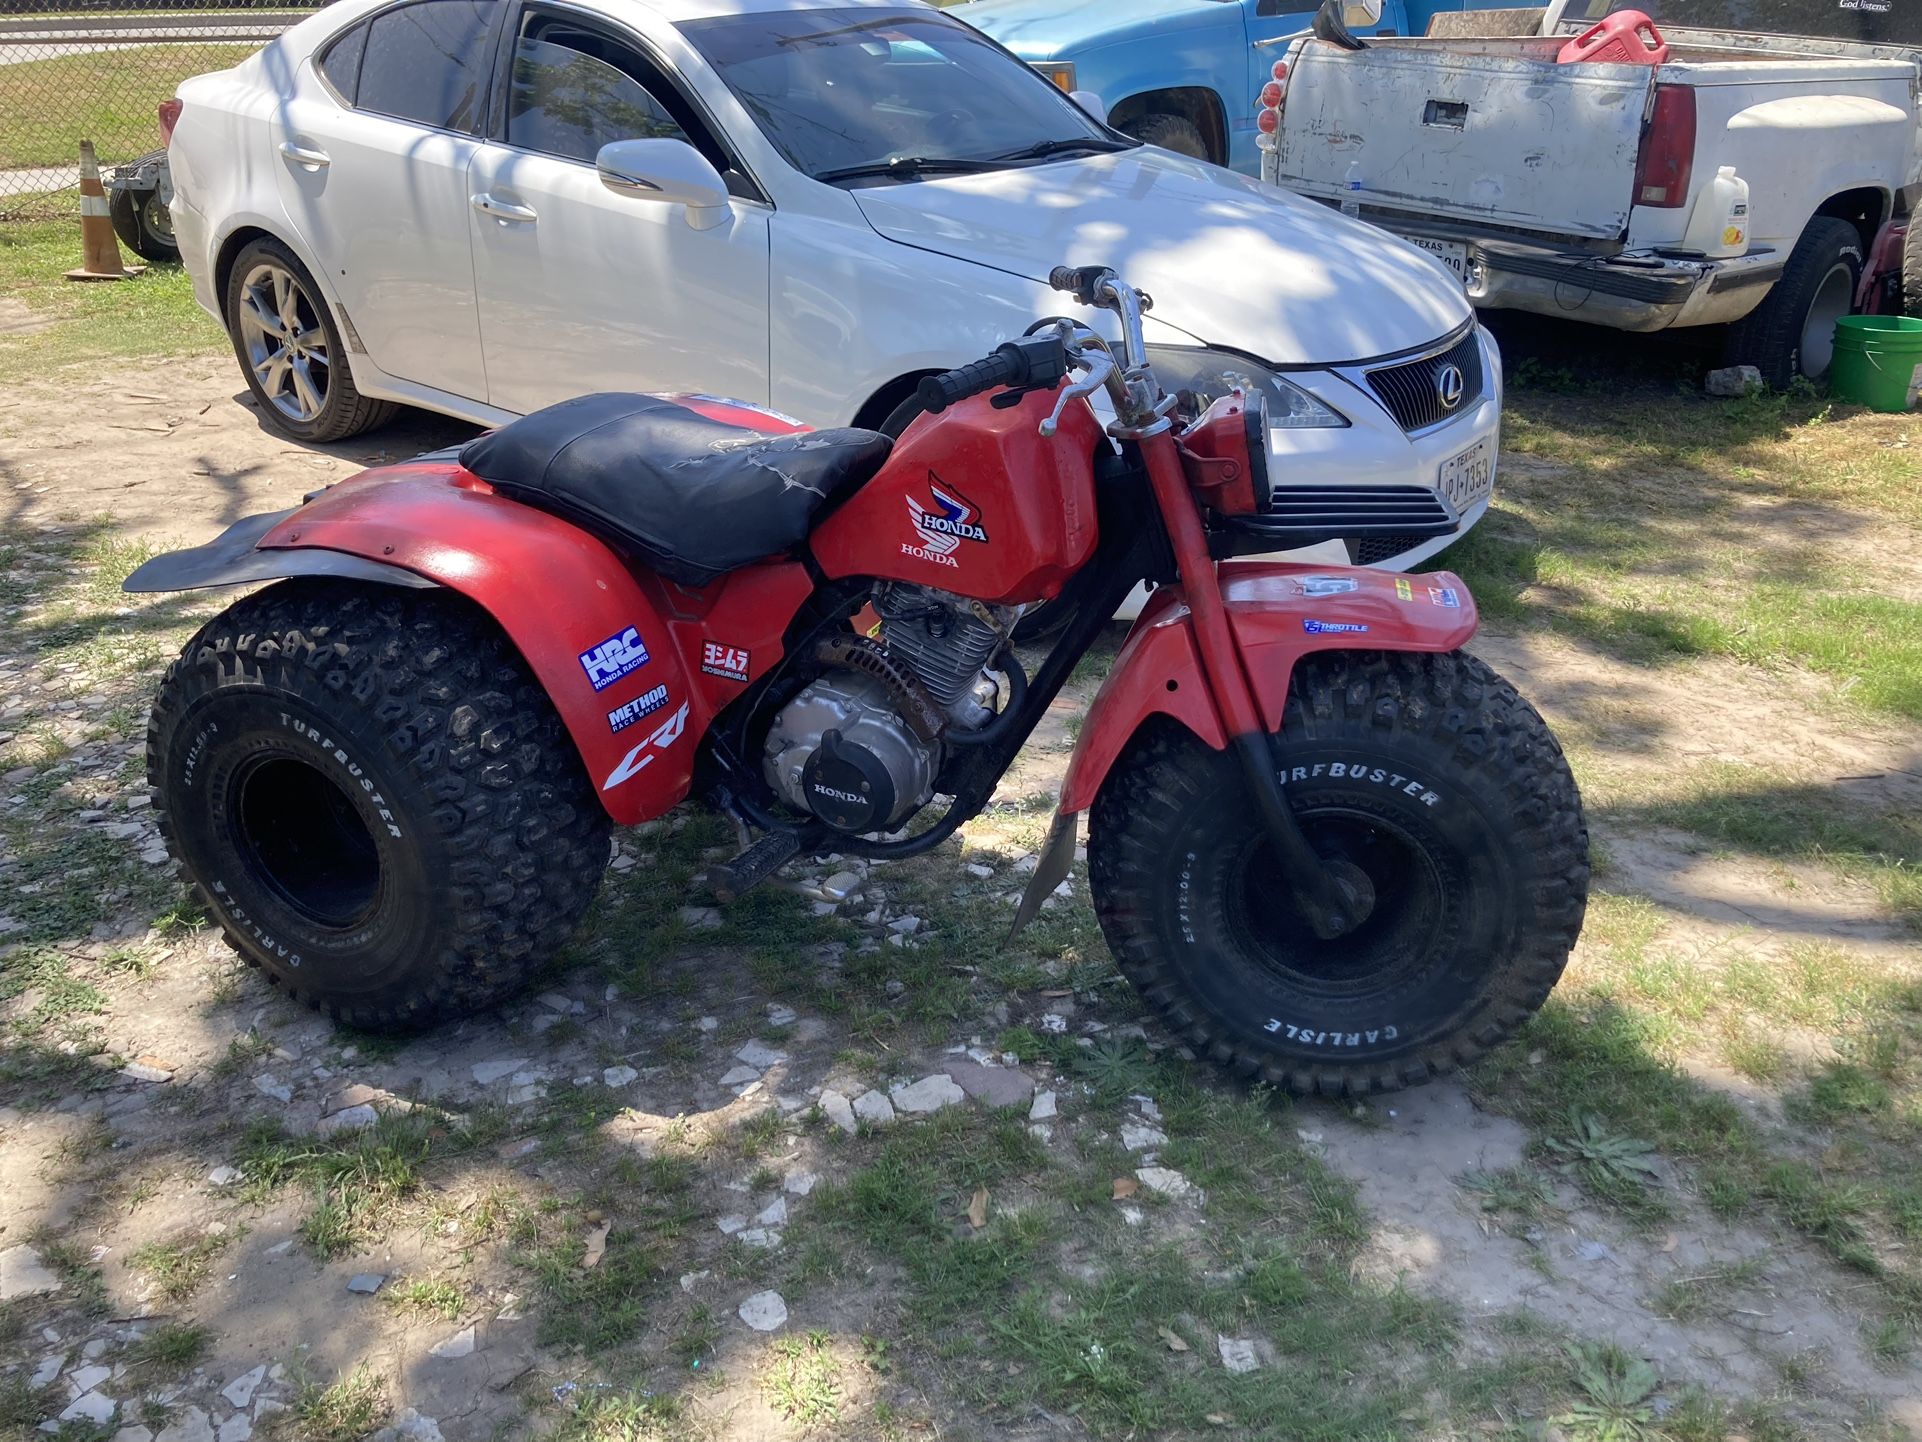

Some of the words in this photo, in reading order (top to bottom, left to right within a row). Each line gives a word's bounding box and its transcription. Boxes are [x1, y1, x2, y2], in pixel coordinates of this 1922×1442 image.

[1413, 239, 1443, 251] TEXAS
[1457, 447, 1477, 467] TEXAS
[923, 514, 987, 541] HONDA
[900, 543, 960, 568] HONDA
[1320, 622, 1369, 633] THROTTLE
[580, 627, 647, 683] HRC
[704, 643, 749, 672] ヨシムラ
[594, 670, 623, 690] HONDA
[622, 653, 649, 673] RACING
[702, 664, 748, 682] YOSHIMURA
[607, 684, 668, 726] METHOD
[612, 715, 635, 733] RACE
[638, 695, 669, 719] WHEELS
[603, 697, 690, 791] CRF
[281, 712, 402, 838] TURFBUSTER
[814, 783, 869, 805] HONDA
[211, 880, 301, 968] CARLISLE
[1263, 1017, 1399, 1046] CARLISLE
